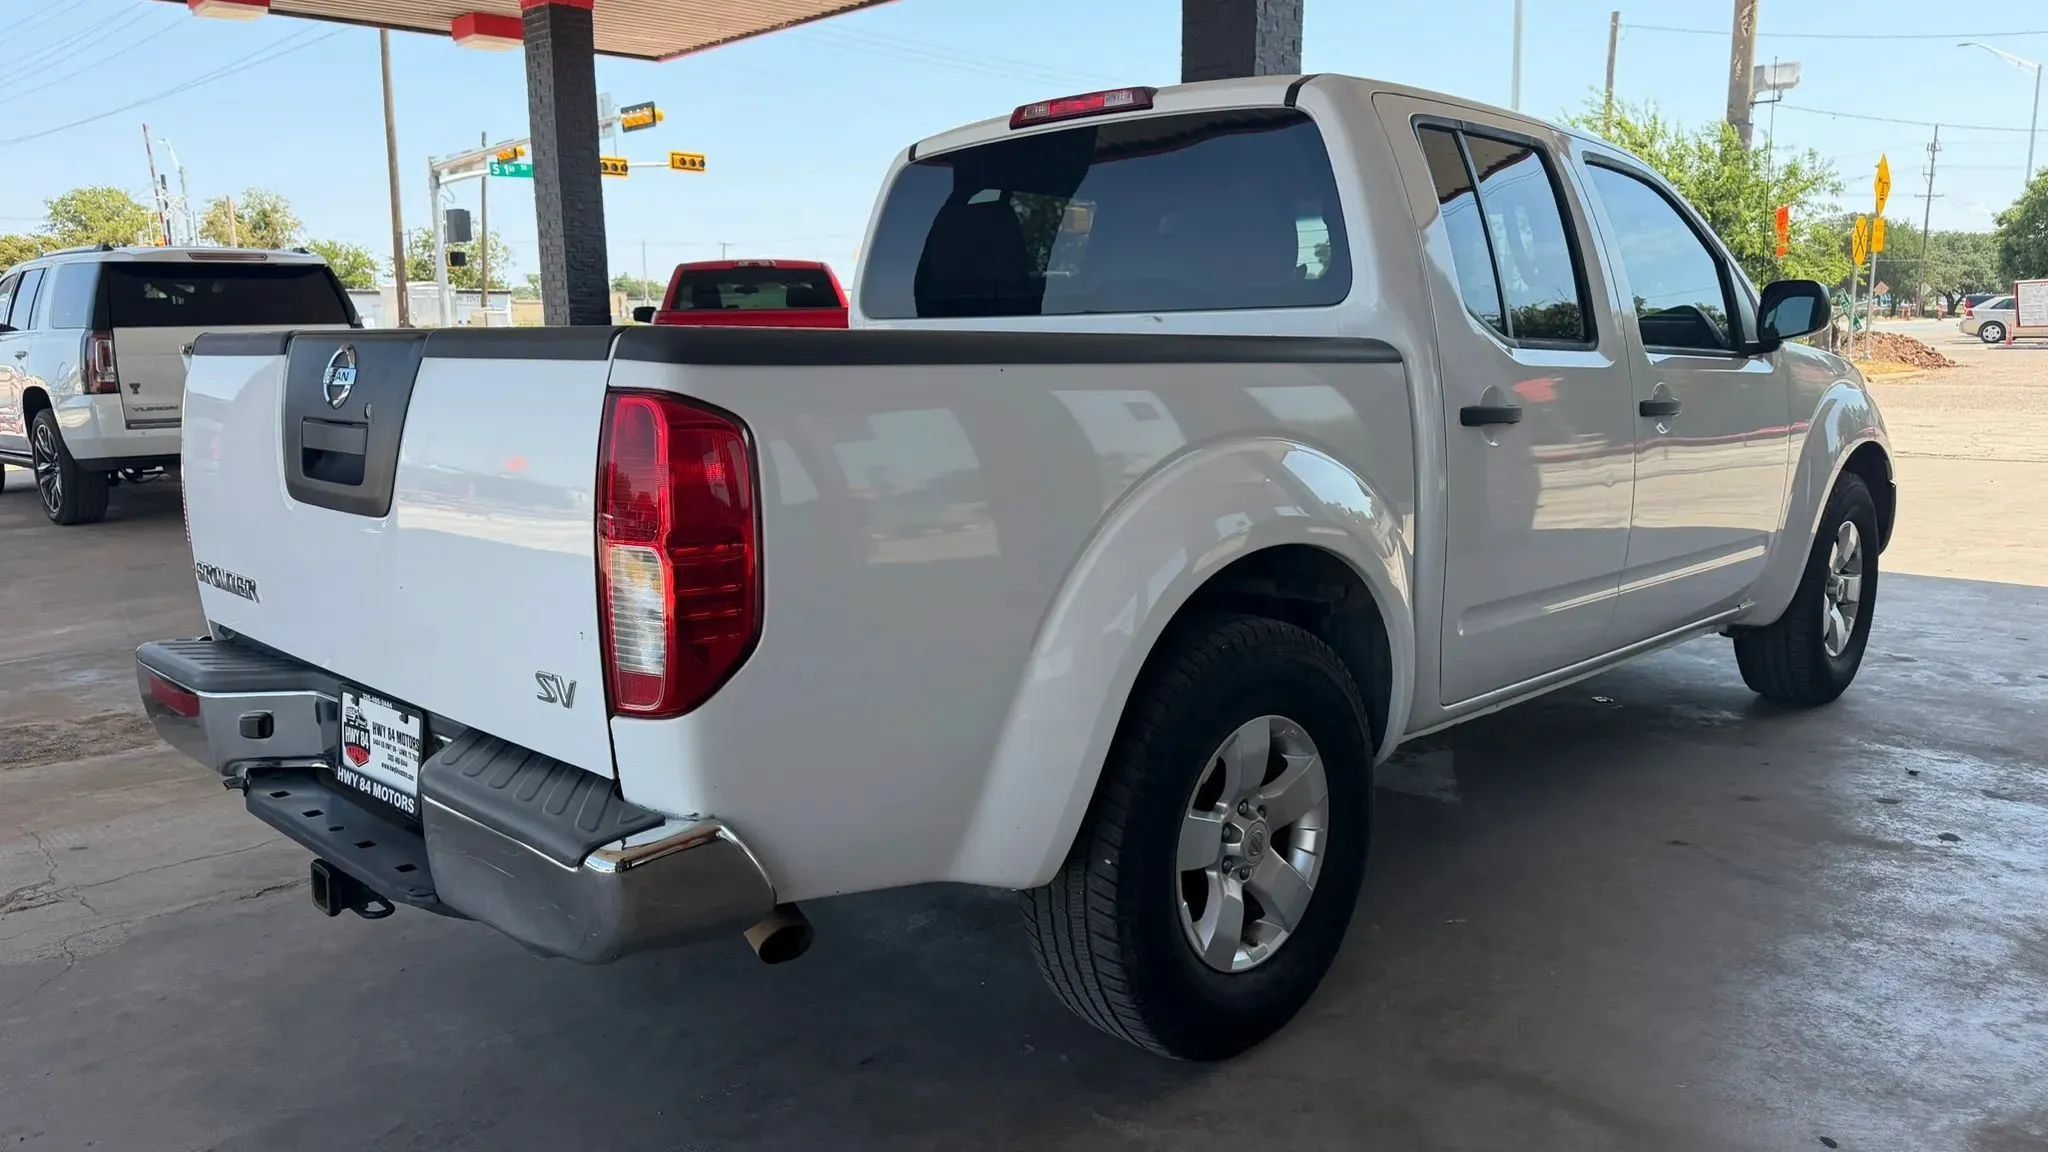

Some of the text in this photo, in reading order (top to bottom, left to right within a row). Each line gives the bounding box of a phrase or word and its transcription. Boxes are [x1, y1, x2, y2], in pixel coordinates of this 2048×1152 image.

[492, 163, 500, 175] S
[535, 670, 577, 709] SV
[345, 725, 369, 750] HWY 84
[372, 721, 387, 739] HWY
[387, 727, 396, 742] 84
[396, 729, 420, 751] MOTORS
[337, 766, 359, 788] HWY
[359, 777, 372, 795] 84
[372, 782, 415, 814] MOTORS
